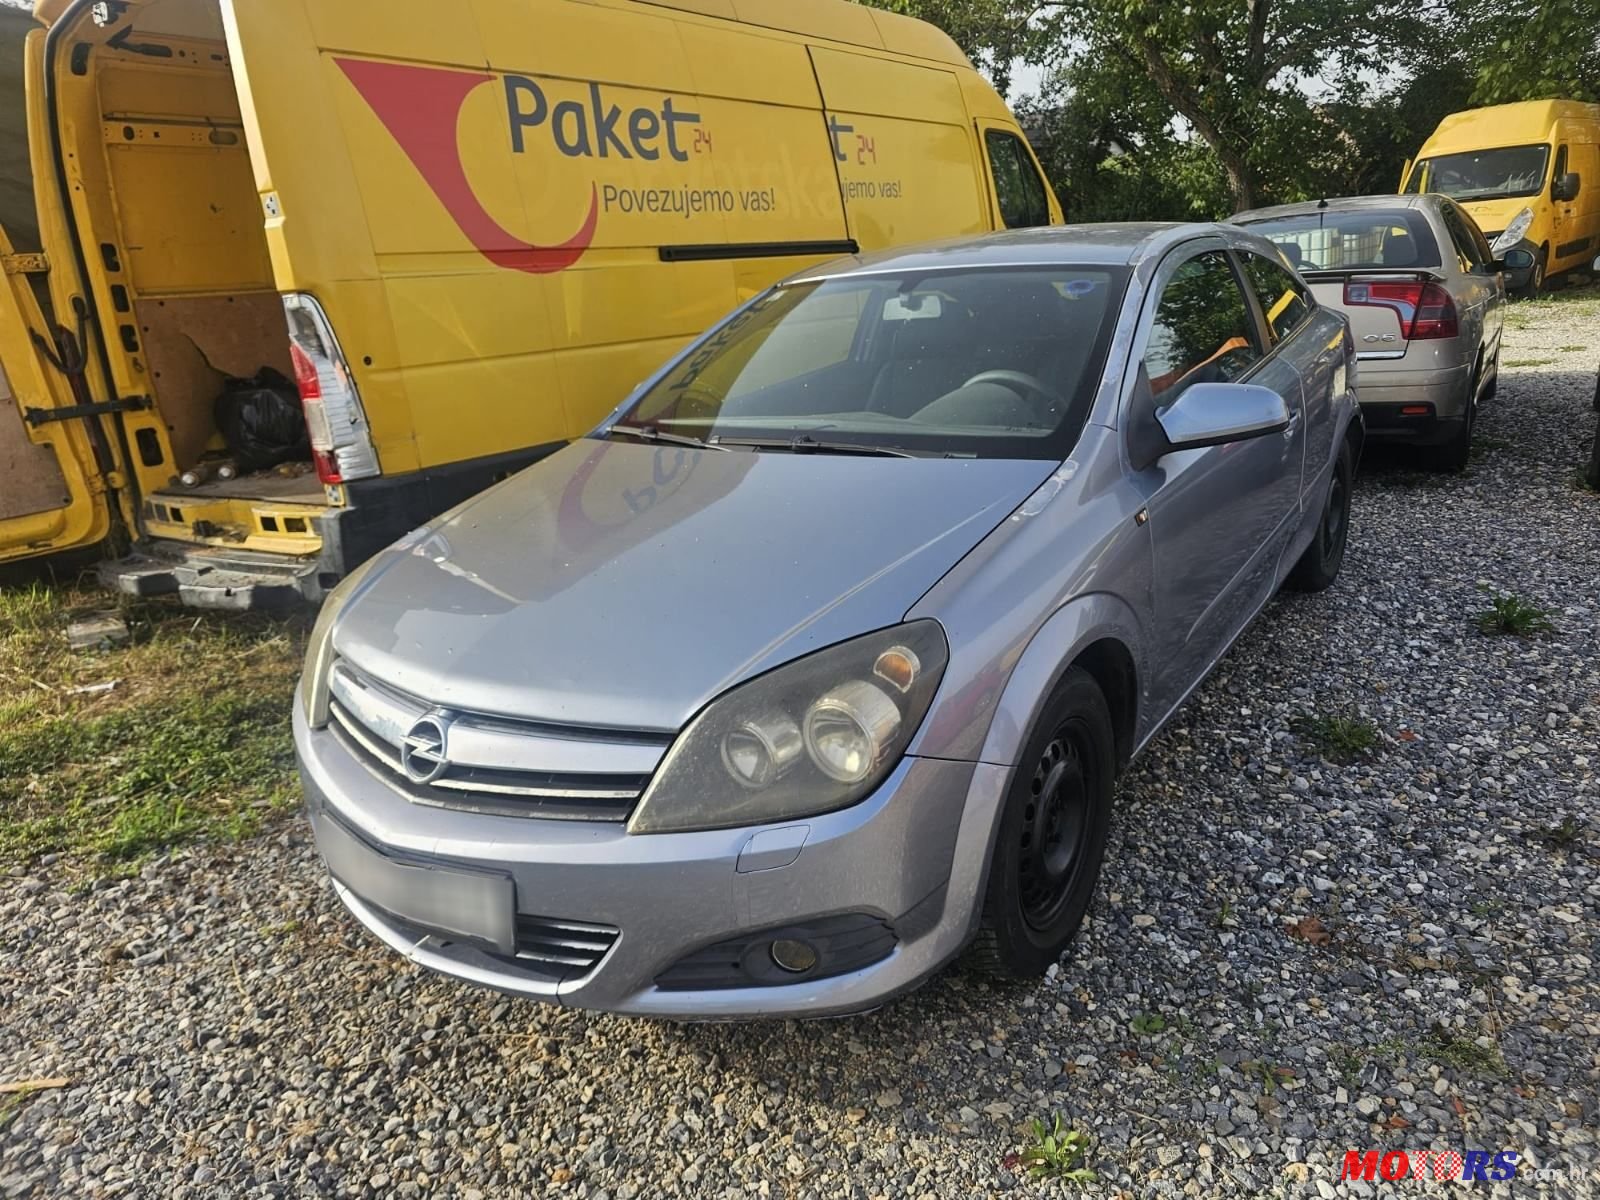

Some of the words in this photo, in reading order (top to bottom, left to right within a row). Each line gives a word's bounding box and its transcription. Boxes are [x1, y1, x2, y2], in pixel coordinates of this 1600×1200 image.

[503, 75, 700, 162] Paket
[693, 128, 713, 154] 24
[856, 134, 877, 166] 24
[603, 183, 734, 219] Povezujemo
[738, 187, 776, 212] vas!
[878, 179, 903, 199] vas!
